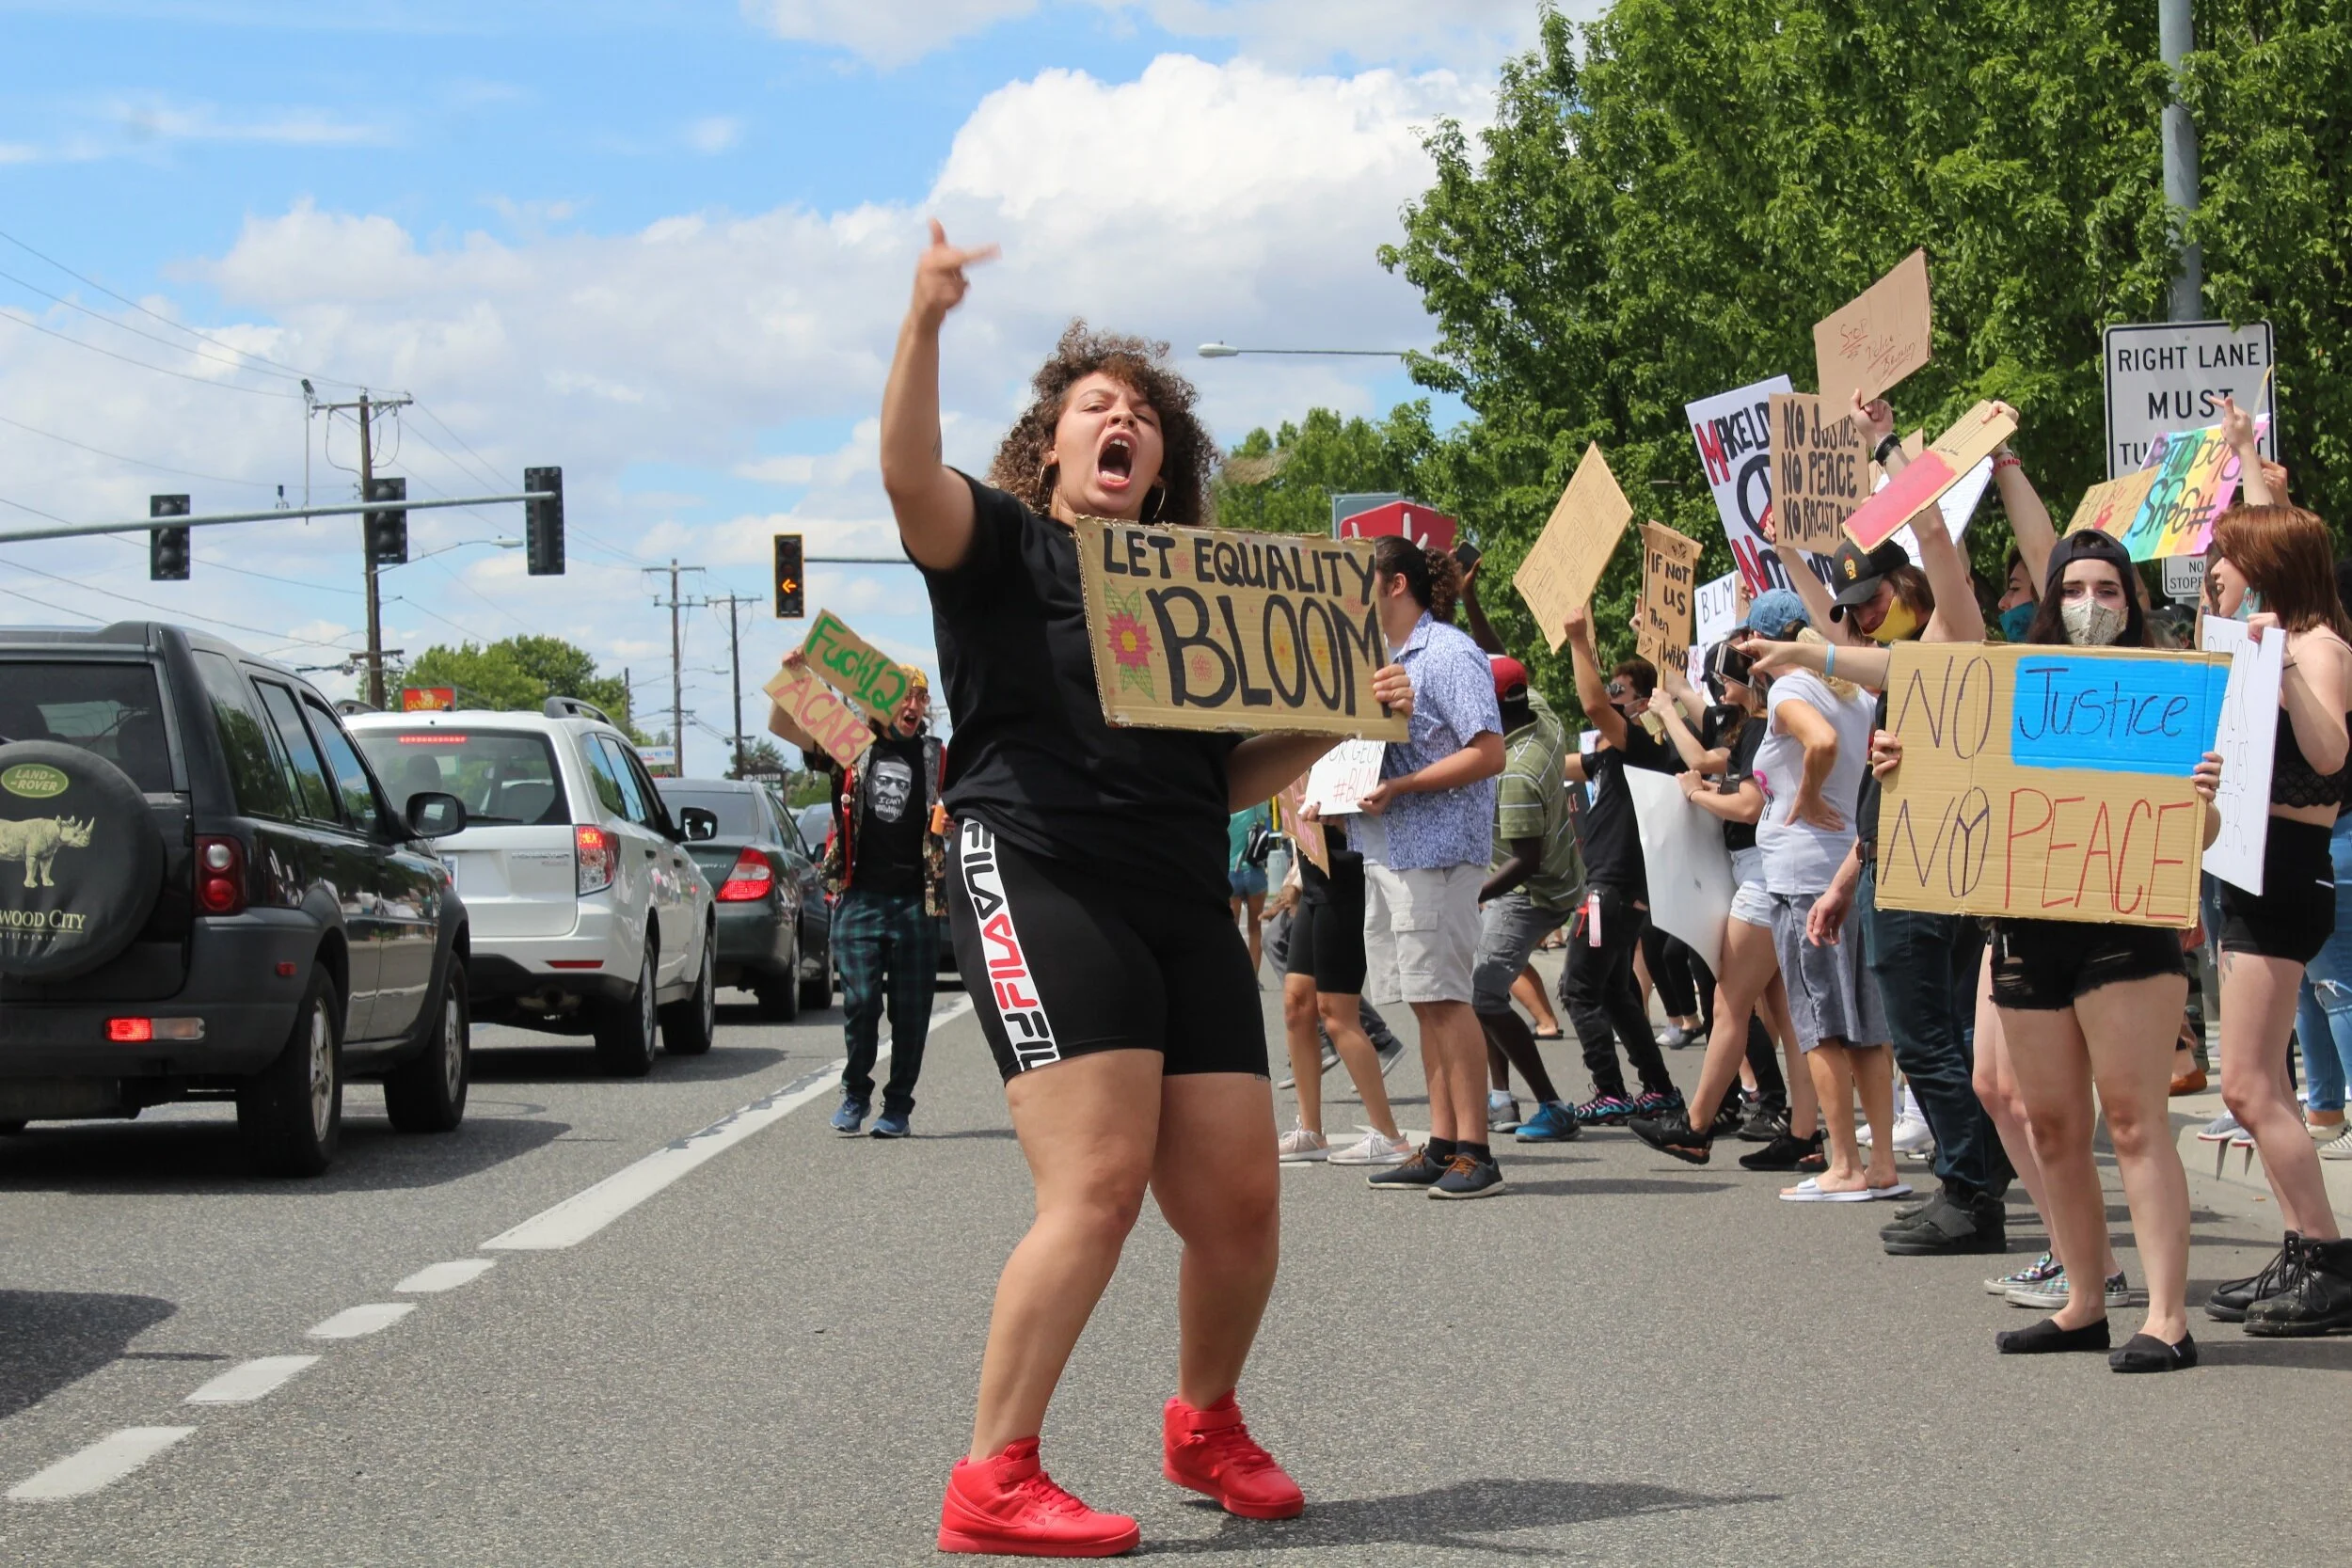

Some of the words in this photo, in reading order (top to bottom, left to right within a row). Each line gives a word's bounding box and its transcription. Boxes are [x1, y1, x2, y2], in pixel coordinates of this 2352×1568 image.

[2118, 346, 2187, 372] RIGHT
[2199, 342, 2261, 368] LANE
[1783, 399, 1804, 451] NO
[1781, 451, 1803, 497] NO
[1808, 451, 1857, 499] PEACE
[2119, 442, 2148, 466] TU
[1783, 497, 1802, 541] NO
[1804, 497, 1835, 543] RACIST
[1103, 528, 1175, 579] LET
[1193, 537, 1375, 606] EQUALITY
[1651, 552, 1663, 574] IF
[1665, 562, 1691, 585] NOT
[2188, 561, 2204, 573] NO
[1663, 585, 1686, 616] US
[1701, 578, 1734, 624] BLM
[1145, 585, 1392, 719] BLOOM
[773, 675, 870, 763] ACAB
[1897, 656, 1993, 759] NO
[2020, 667, 2188, 740] Justice
[963, 822, 1004, 920] FILA
[1882, 786, 1990, 898] NO
[2005, 787, 2195, 919] PEACE
[0, 910, 45, 927] WOOD
[983, 913, 1038, 1010] FILA
[1005, 1010, 1057, 1069] FIL
